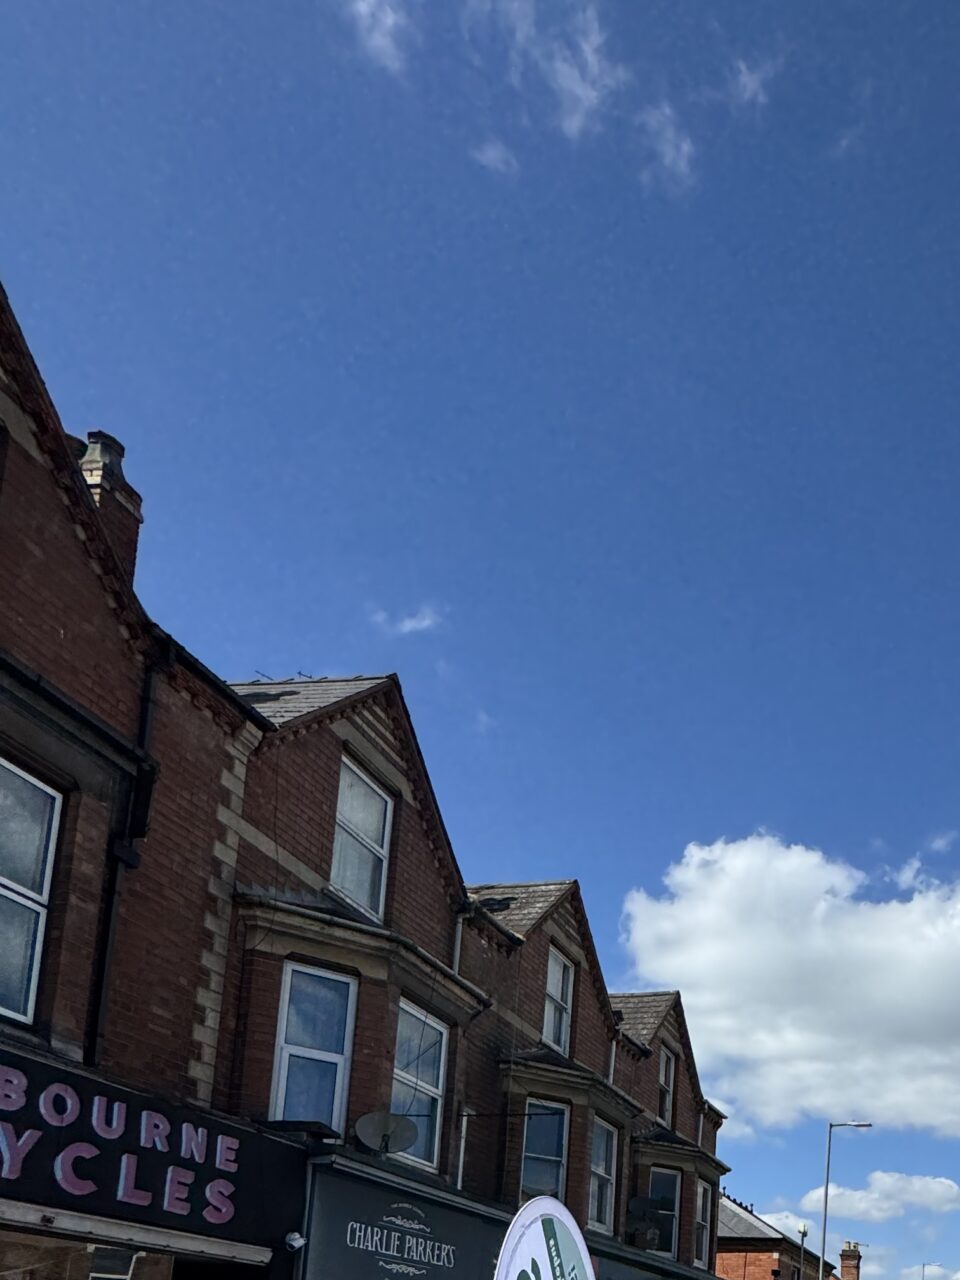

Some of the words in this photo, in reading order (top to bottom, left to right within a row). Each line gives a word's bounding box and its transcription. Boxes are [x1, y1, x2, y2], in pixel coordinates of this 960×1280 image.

[0, 1064, 240, 1173] BOURNE
[0, 1120, 237, 1225] YCLES
[347, 1221, 402, 1257] CHARLIE
[403, 1234, 457, 1268] PARKER'S
